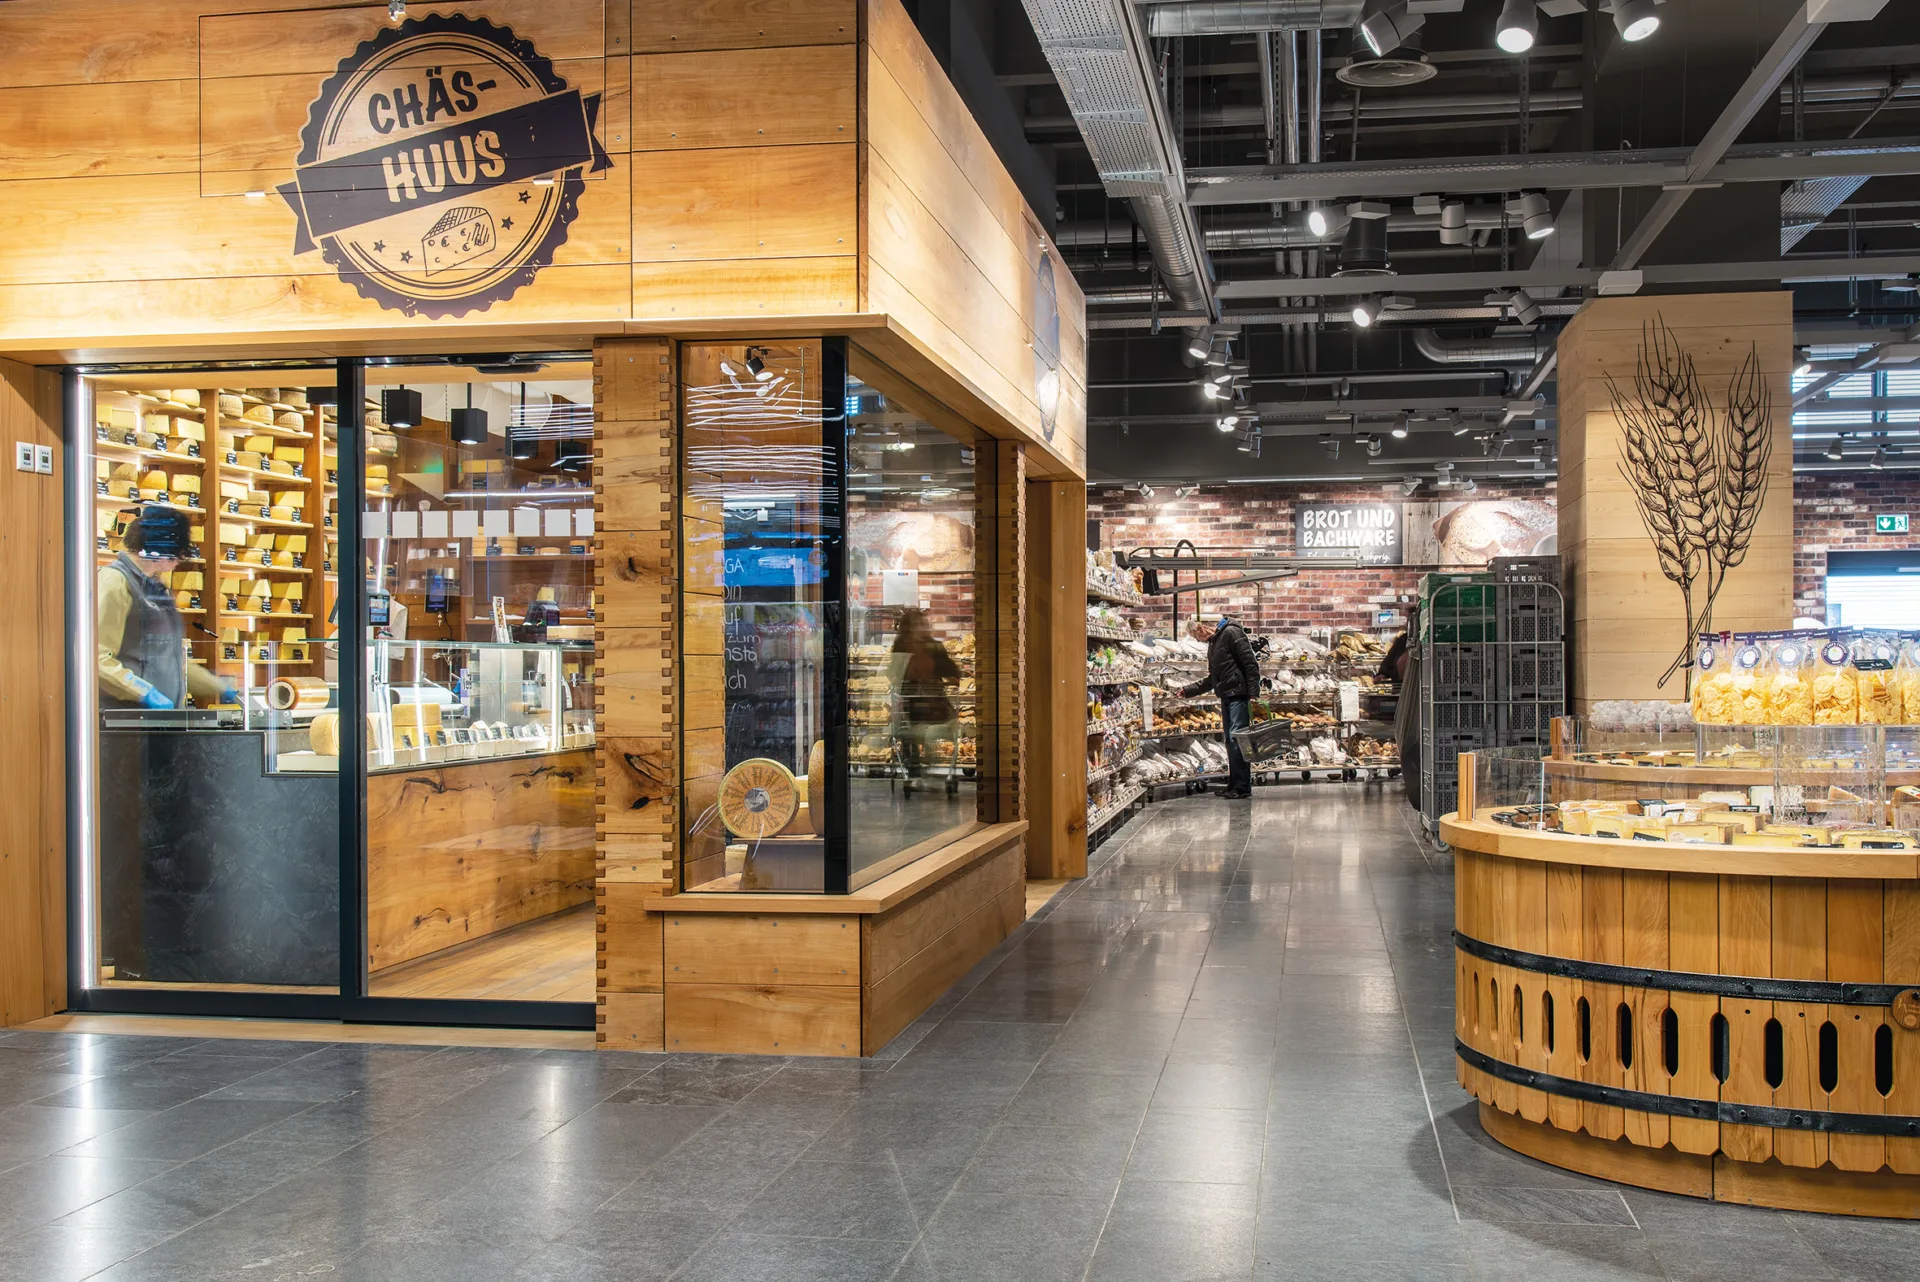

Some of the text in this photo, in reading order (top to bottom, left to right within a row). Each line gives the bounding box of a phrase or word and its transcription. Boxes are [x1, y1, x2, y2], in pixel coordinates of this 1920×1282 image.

[368, 66, 497, 135] CHÄS-
[381, 130, 506, 203] HUUS
[1303, 508, 1395, 529] BROT UND
[1303, 529, 1395, 547] BACHWARE
